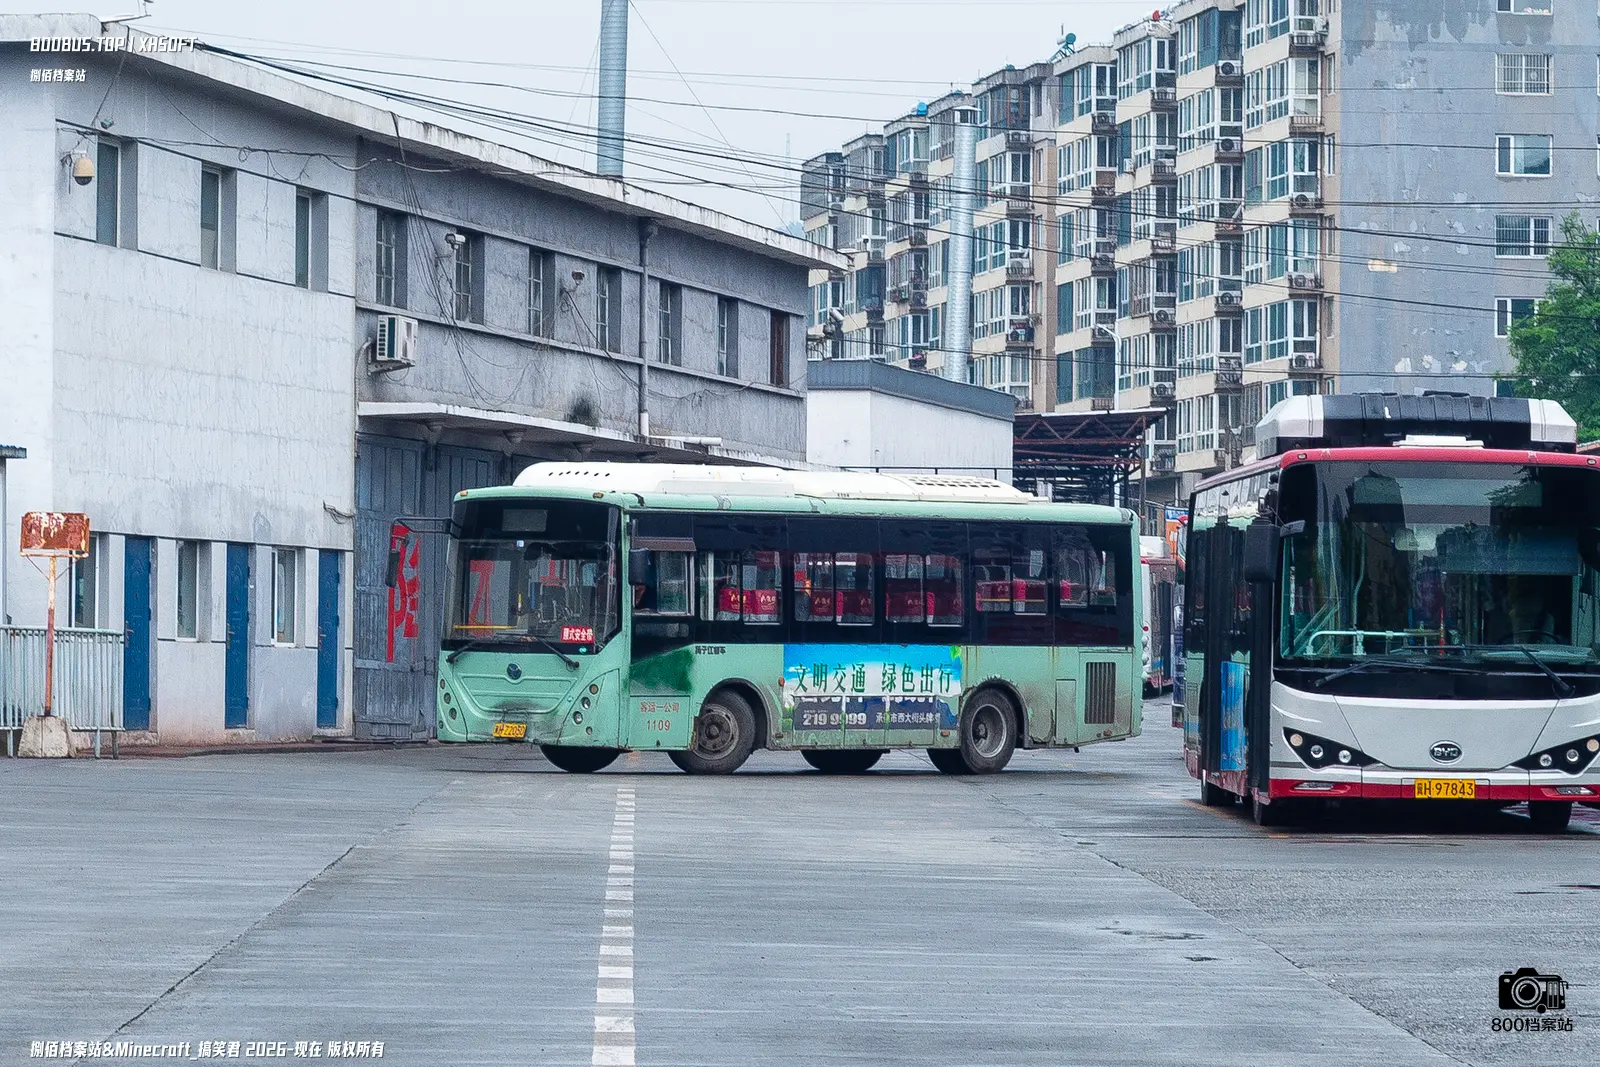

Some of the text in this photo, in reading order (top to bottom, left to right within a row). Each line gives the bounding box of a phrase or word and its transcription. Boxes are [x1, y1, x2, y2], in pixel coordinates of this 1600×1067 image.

[794, 663, 953, 693] 文明交通 绿色出行
[802, 712, 827, 726] 219
[647, 720, 671, 731] 1109
[1434, 748, 1459, 756] BYD
